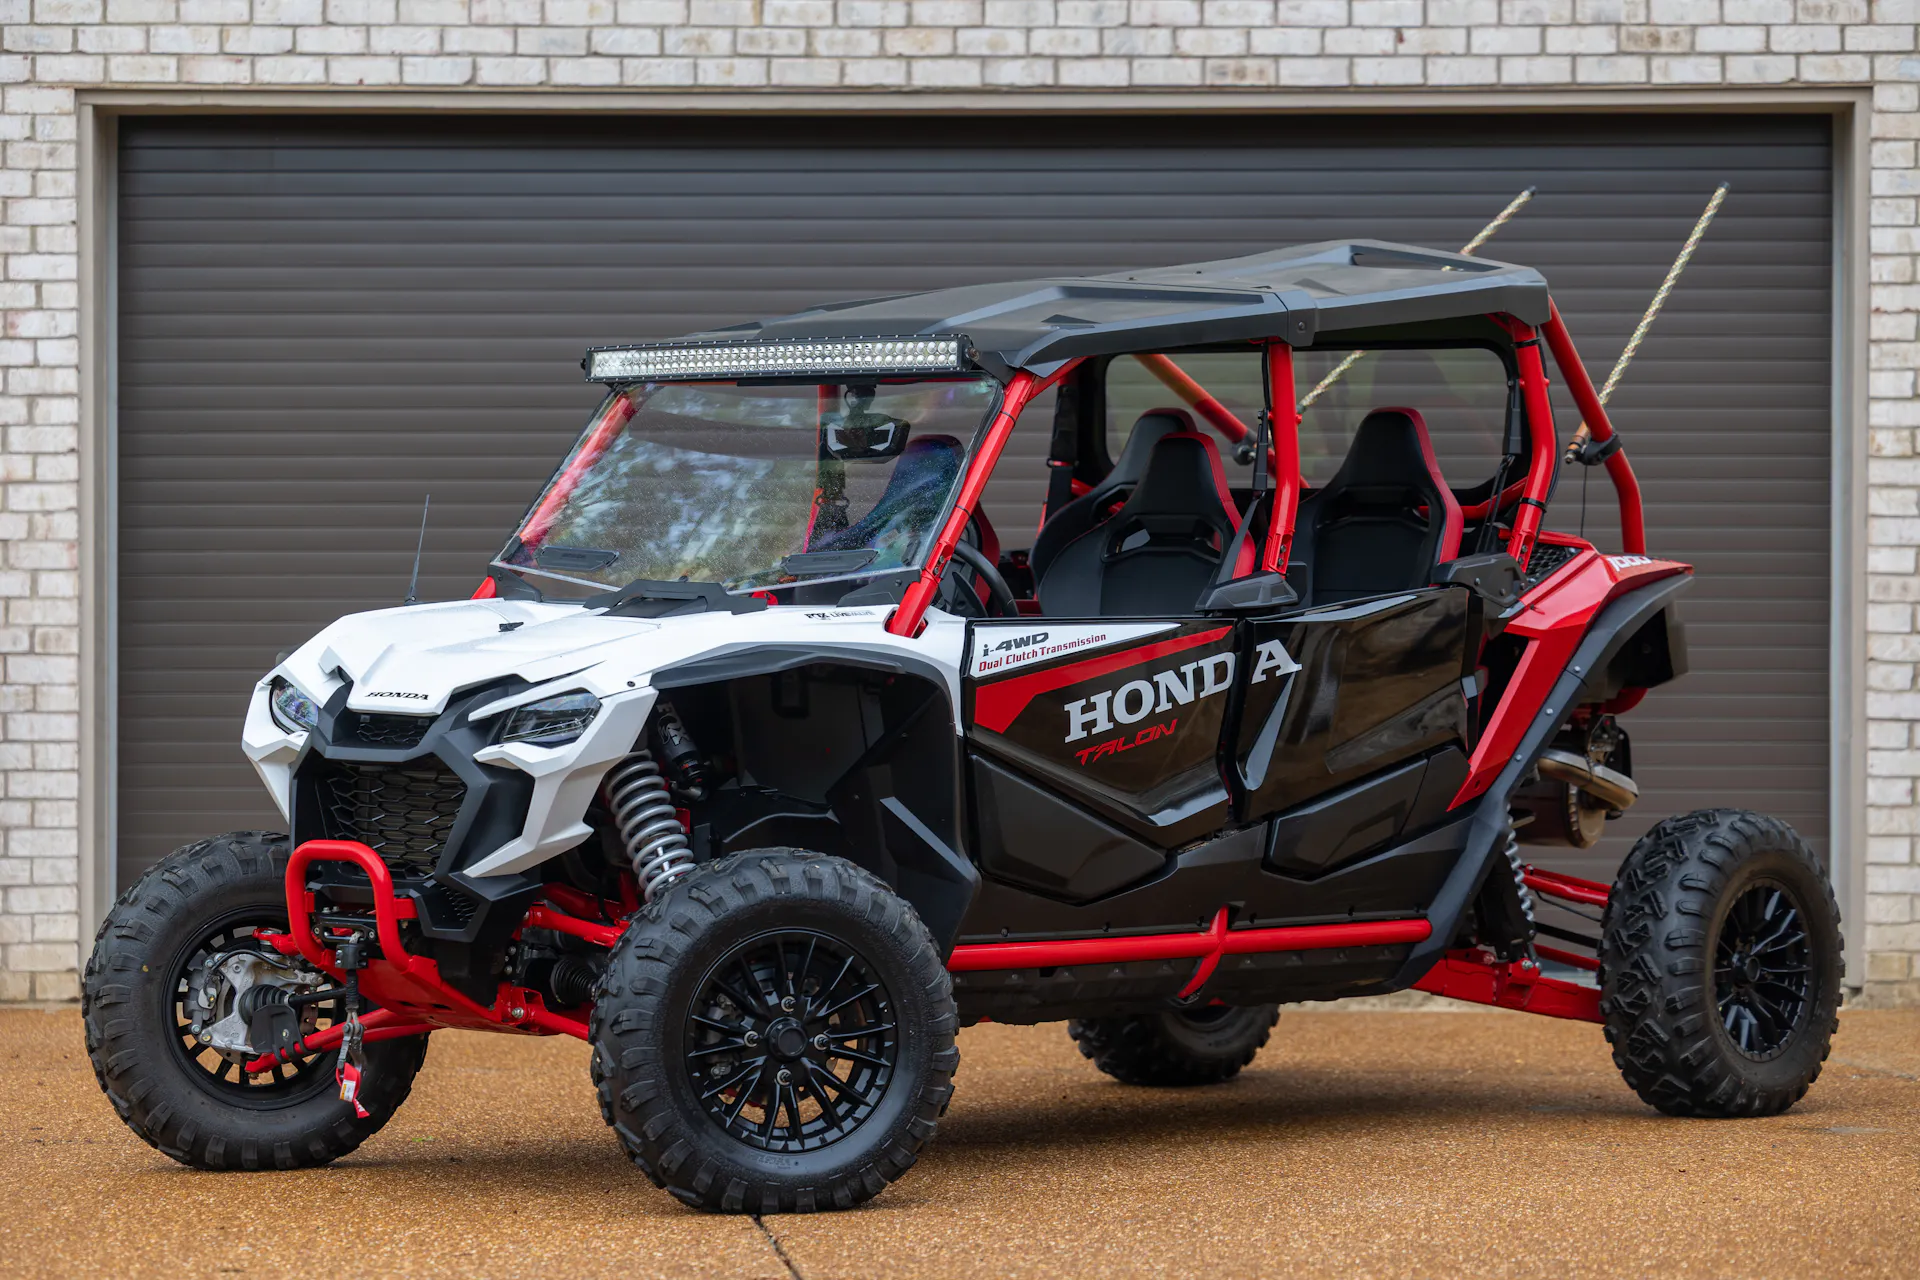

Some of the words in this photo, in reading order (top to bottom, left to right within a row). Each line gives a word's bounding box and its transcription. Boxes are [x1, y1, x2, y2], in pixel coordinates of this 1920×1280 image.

[979, 656, 1003, 672] Dual
[1005, 648, 1038, 665] Clutch
[1039, 634, 1106, 656] Transmission
[982, 632, 1049, 657] i-4WD
[365, 691, 429, 700] HONDA
[1064, 638, 1303, 743] HONDA
[1075, 718, 1178, 766] TALON
